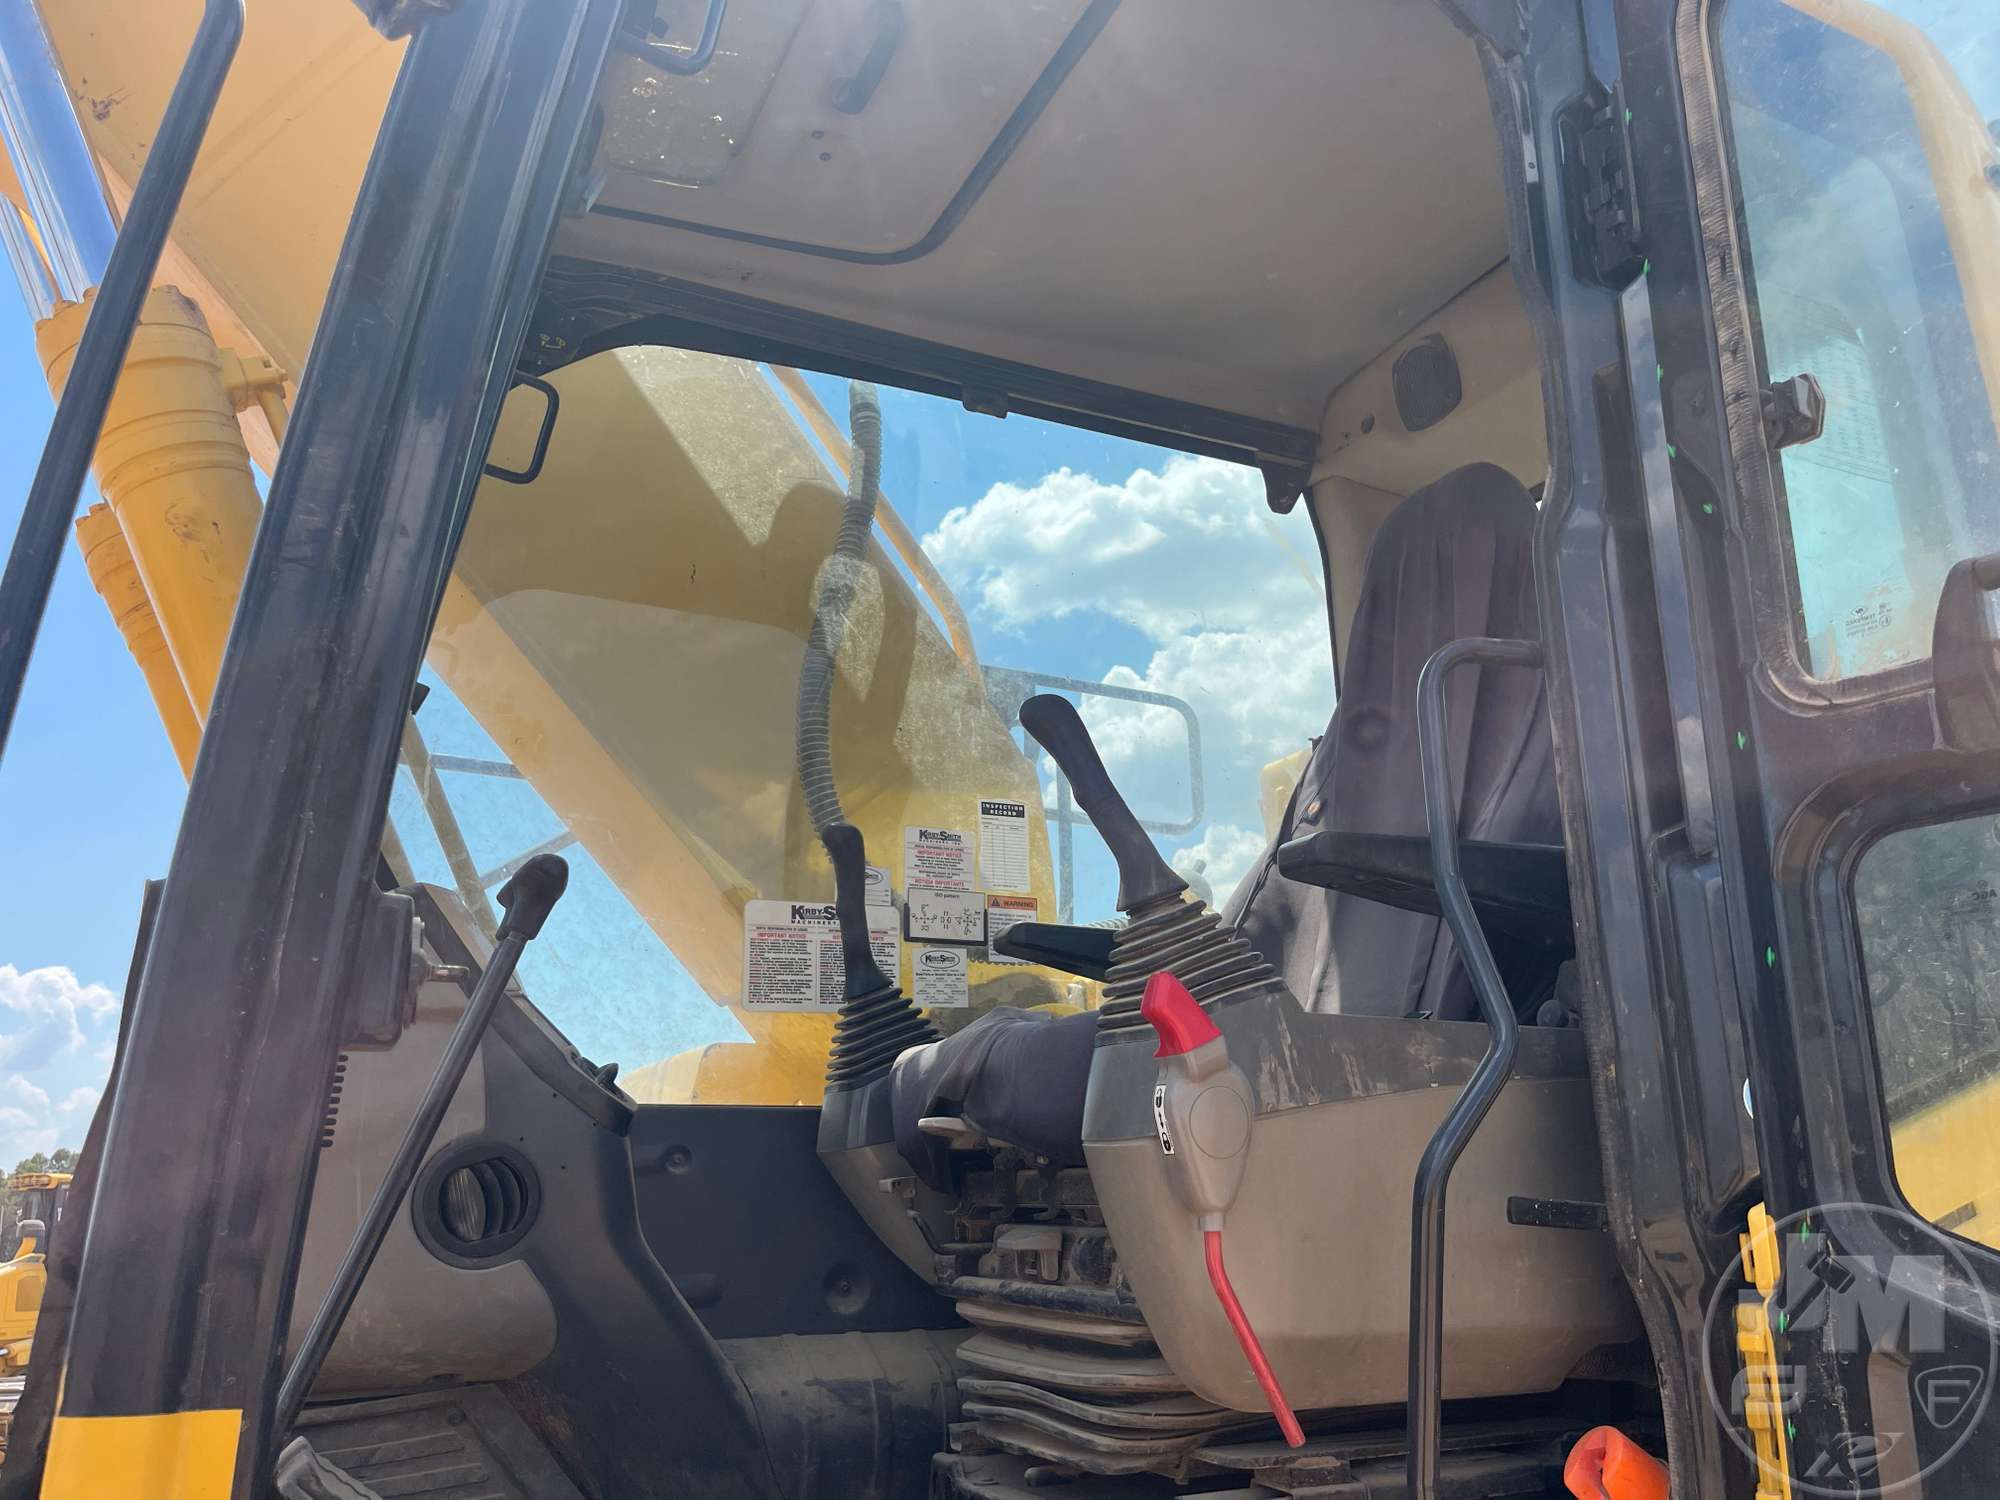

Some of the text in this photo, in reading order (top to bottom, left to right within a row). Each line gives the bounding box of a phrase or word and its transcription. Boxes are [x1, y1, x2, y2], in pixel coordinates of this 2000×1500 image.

[982, 803, 1024, 811] INSPECTION
[1003, 900, 1034, 908] WARNING
[791, 905, 838, 920] KIRBY-S
